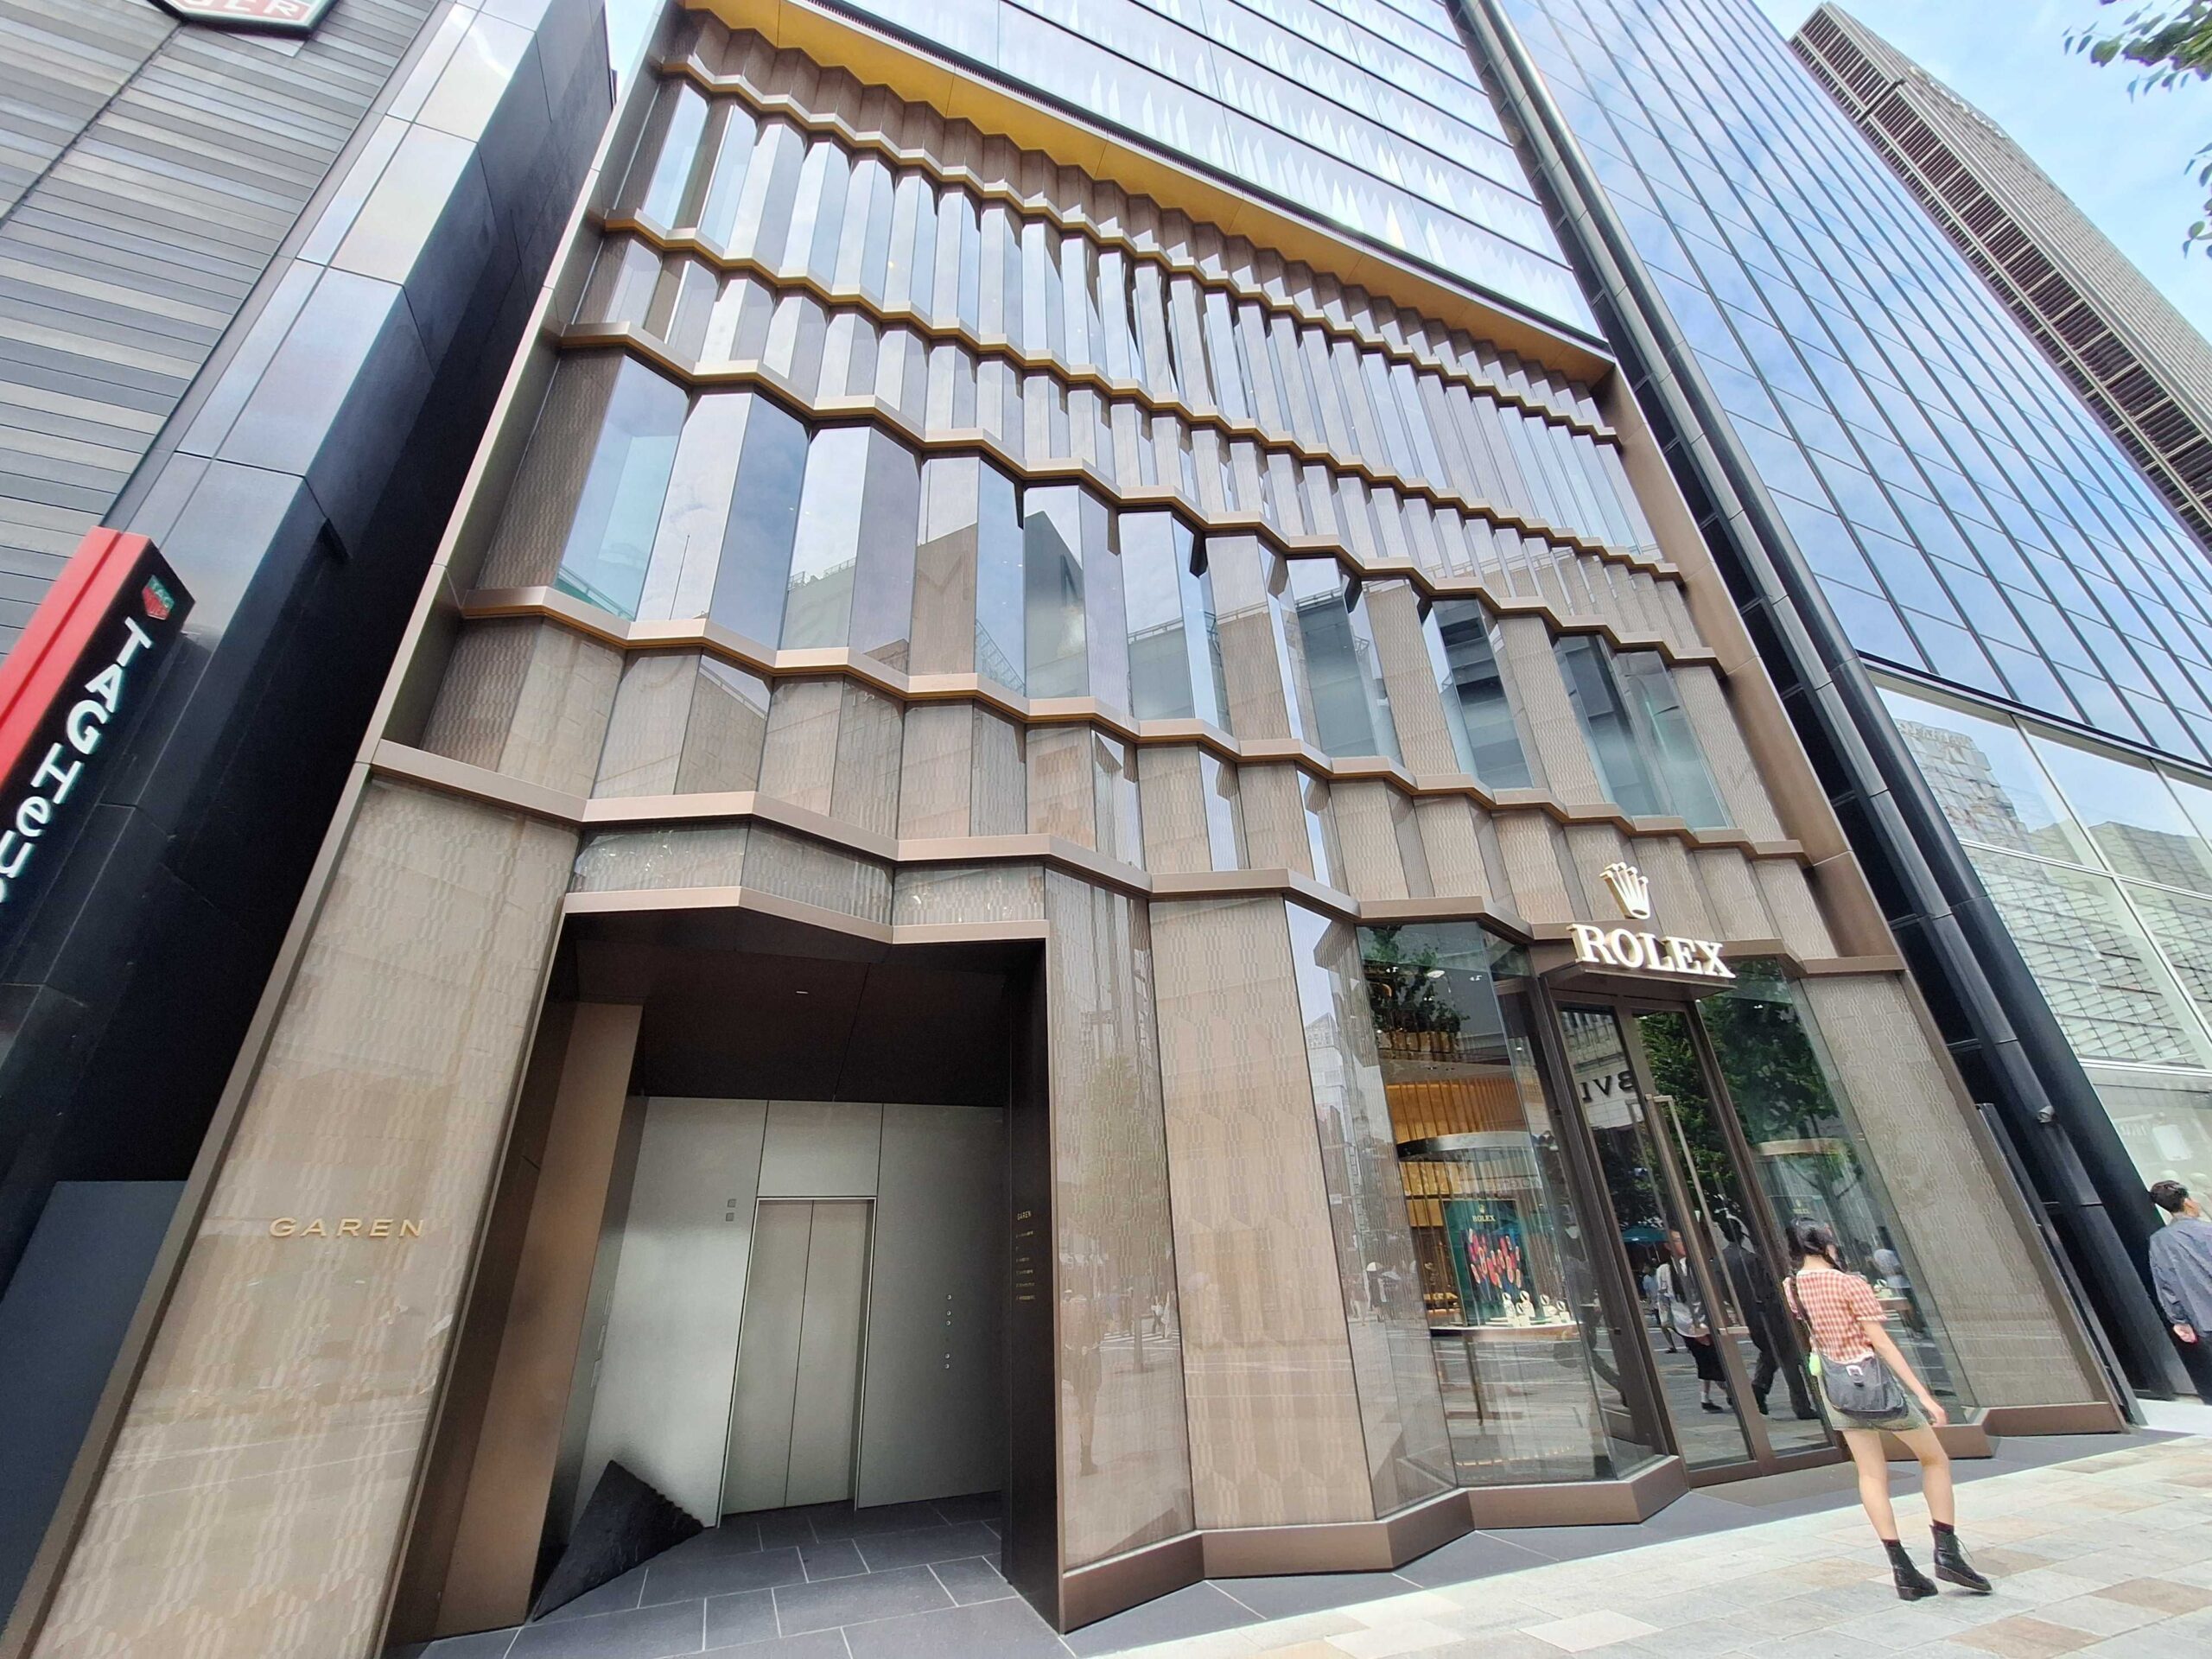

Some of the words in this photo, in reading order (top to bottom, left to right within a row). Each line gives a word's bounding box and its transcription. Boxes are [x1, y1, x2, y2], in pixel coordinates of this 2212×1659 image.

[1567, 924, 1737, 978] ROLEX
[269, 1217, 424, 1237] GAREN
[1471, 1214, 1496, 1223] ROLEX
